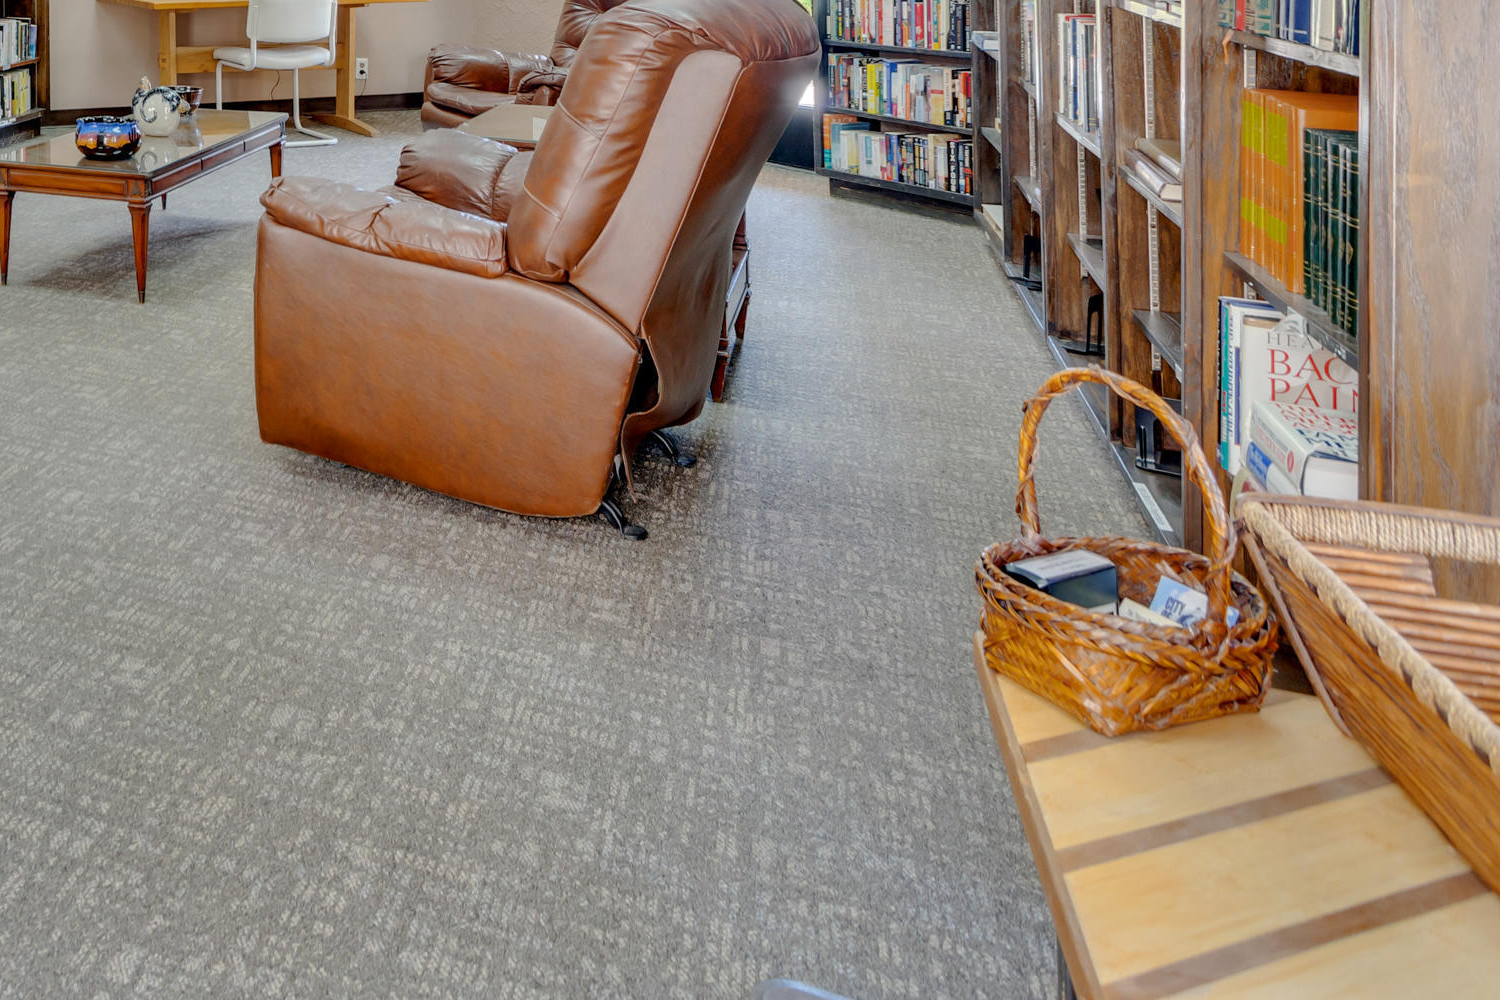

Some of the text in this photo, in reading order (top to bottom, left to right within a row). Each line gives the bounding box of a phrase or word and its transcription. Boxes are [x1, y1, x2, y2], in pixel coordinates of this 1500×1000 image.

[1267, 331, 1324, 351] HEA
[1267, 348, 1357, 385] BAC
[1165, 596, 1186, 616] CITY
